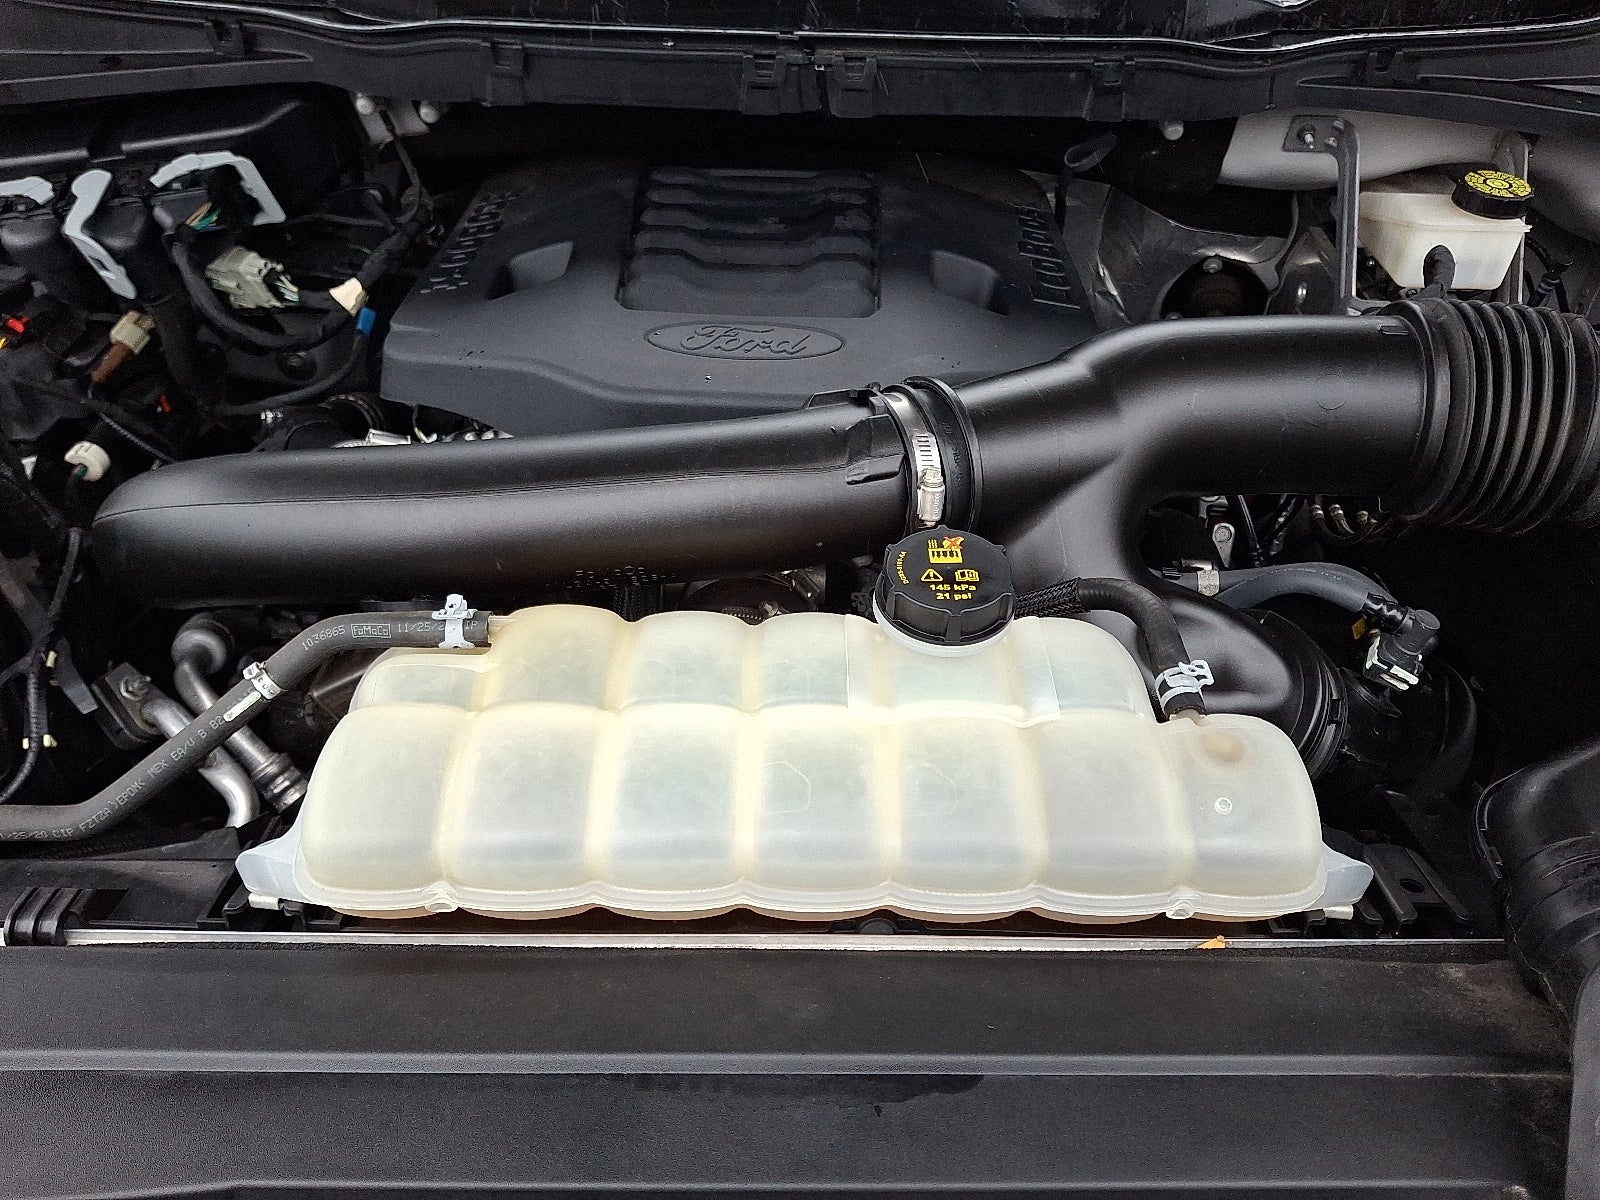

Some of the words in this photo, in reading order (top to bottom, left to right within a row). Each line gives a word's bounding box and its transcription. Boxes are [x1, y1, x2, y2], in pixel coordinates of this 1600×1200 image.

[679, 324, 811, 356] Ford
[301, 625, 346, 651] 1036865
[352, 624, 391, 638] FoMoCo
[397, 621, 445, 633] 11/25/2
[197, 729, 207, 739] B
